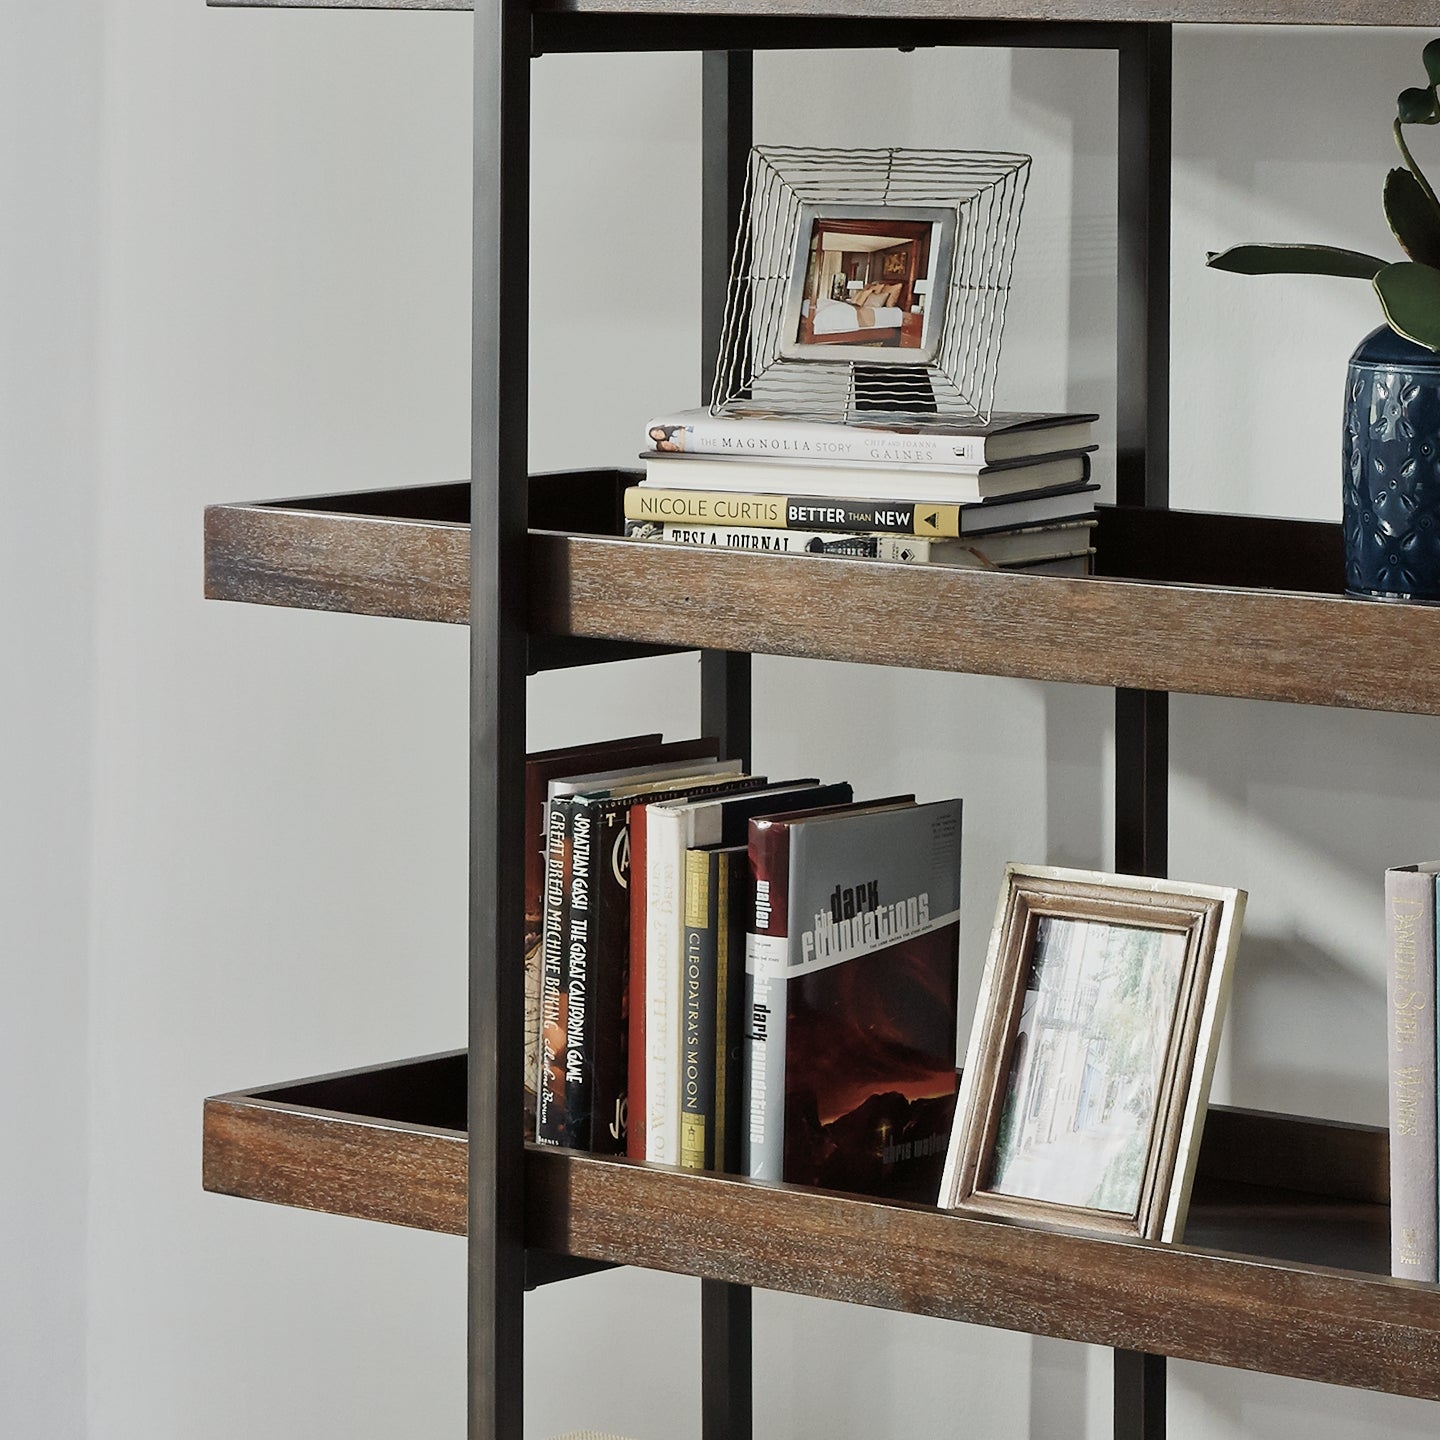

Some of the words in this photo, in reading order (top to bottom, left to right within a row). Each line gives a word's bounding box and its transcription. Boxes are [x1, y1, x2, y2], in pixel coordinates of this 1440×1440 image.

[701, 438, 717, 447] THE
[722, 437, 810, 451] MAGNOLIA
[816, 442, 852, 453] STORY
[864, 439, 885, 447] CHIP
[902, 441, 937, 449] JOANNA
[870, 448, 933, 461] GAINES
[641, 498, 707, 517] NICOLE
[714, 501, 777, 520] CURTIS
[789, 506, 845, 523] BETTER
[849, 512, 872, 522] THAN
[874, 510, 910, 526] NEW
[550, 811, 565, 857] GREAT
[571, 813, 591, 877] JONATHAN
[548, 859, 564, 906] BREAD
[571, 878, 588, 910] GASH
[831, 880, 879, 925] dark
[545, 909, 562, 974] MACHINE
[570, 920, 588, 942] THE
[568, 942, 587, 980] GREAT
[543, 976, 560, 1031] BAKING
[687, 933, 700, 1045] CLEOPATRA'S
[567, 981, 586, 1048] CALIFORNIA
[746, 1004, 771, 1041] dark
[566, 1050, 583, 1083] GAME
[686, 1051, 699, 1108] MOON
[1394, 1065, 1424, 1137] WINGS
